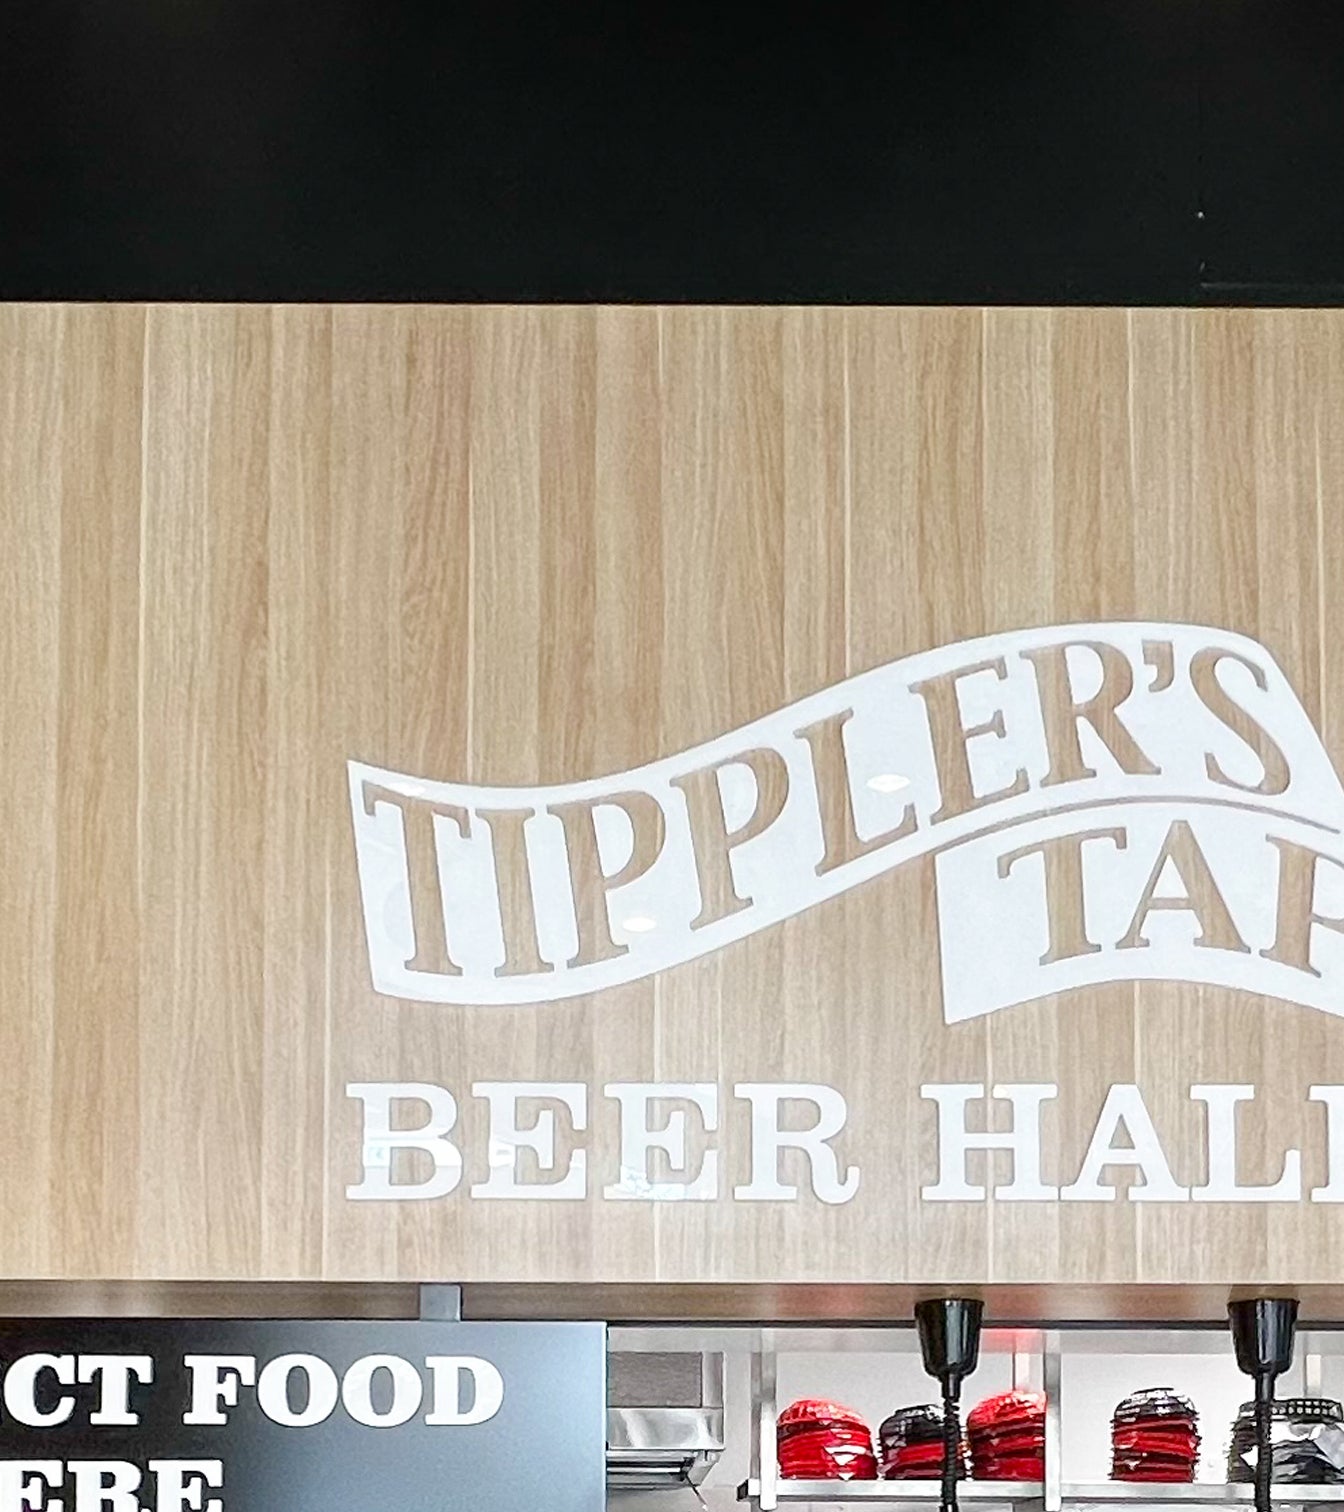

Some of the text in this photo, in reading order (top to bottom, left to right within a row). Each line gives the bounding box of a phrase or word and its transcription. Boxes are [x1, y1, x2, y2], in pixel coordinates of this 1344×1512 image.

[360, 638, 1296, 978] TIPPLER'S
[345, 1080, 859, 1206] BEER
[183, 1353, 504, 1427] FOOD
